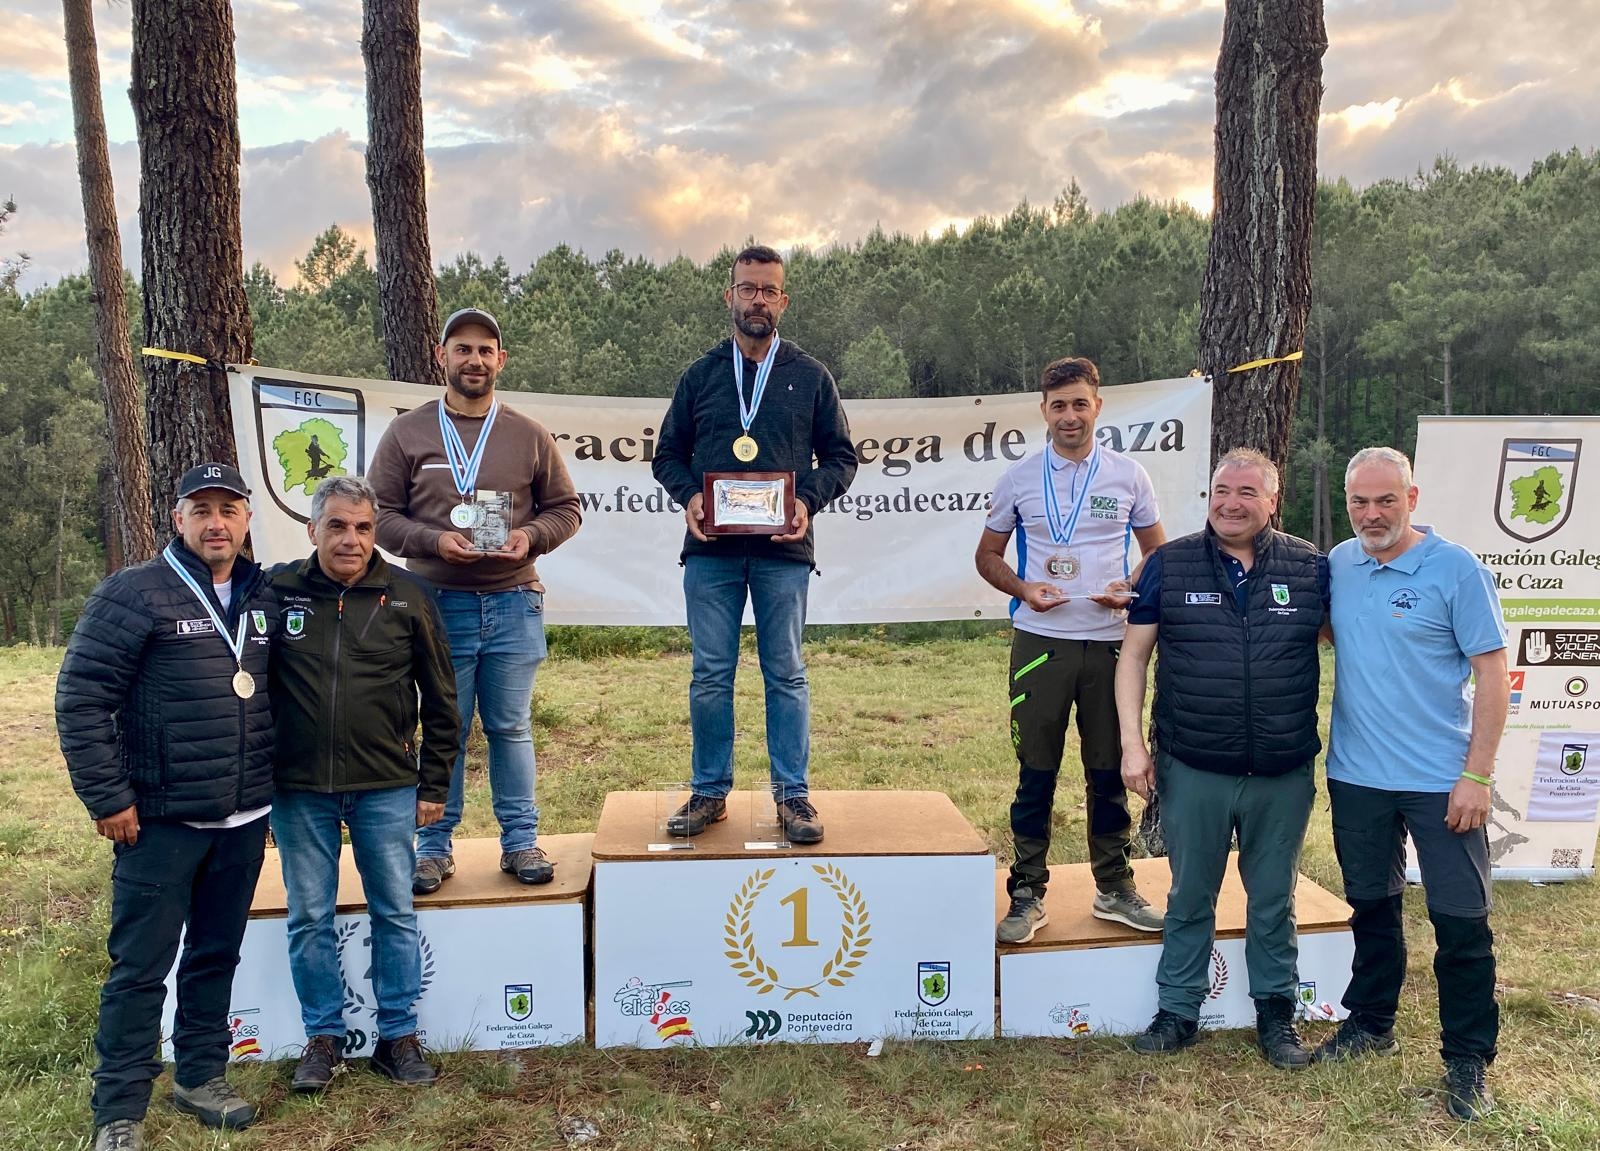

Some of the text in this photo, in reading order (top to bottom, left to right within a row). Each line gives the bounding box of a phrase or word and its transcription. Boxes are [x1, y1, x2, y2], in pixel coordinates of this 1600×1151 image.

[294, 391, 322, 407] FGC
[854, 418, 1186, 477] ega de aza
[1531, 446, 1552, 457] FGC
[203, 466, 222, 478] JG
[1475, 549, 1600, 571] ración Galeg
[1517, 573, 1564, 590] Caza
[1501, 605, 1600, 618] ngalegadecaza.
[1555, 633, 1599, 643] STOP
[1555, 643, 1600, 651] VIOLEN
[1530, 700, 1600, 710] MUTUASPO
[779, 886, 819, 948] 1
[621, 998, 691, 1016] elicio.es
[787, 1010, 853, 1024] Deputación
[944, 1008, 973, 1018] Galega
[486, 1022, 553, 1032] Federación Galega
[787, 1023, 853, 1033] Pontevedra
[919, 1018, 952, 1028] de Caza
[500, 1039, 542, 1047] Pontevedra
